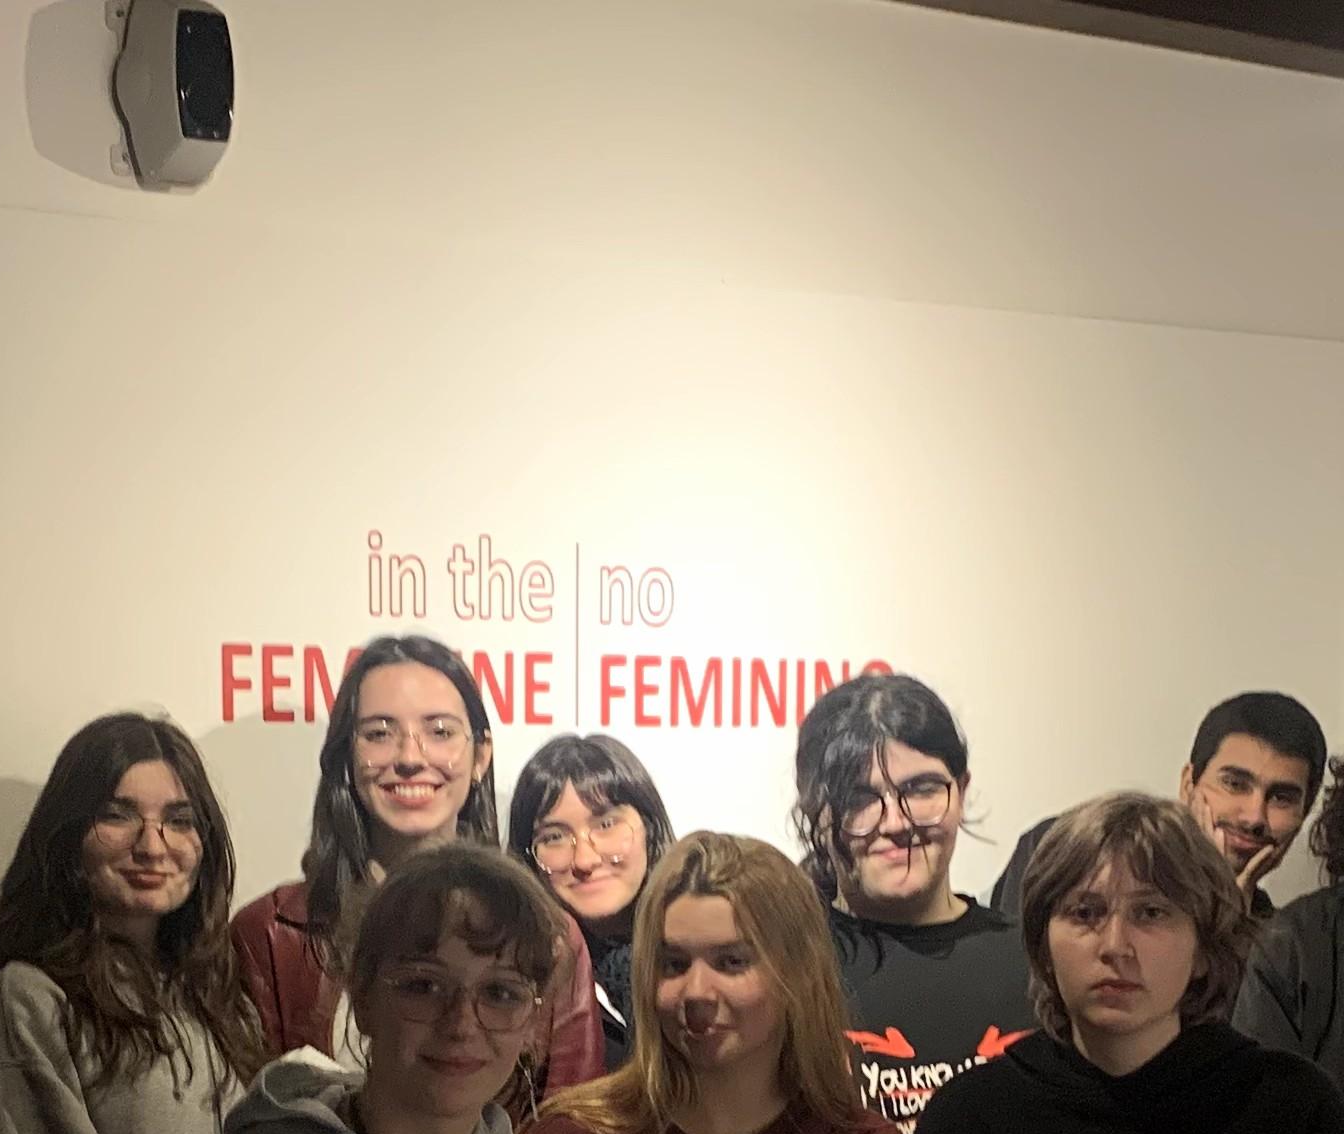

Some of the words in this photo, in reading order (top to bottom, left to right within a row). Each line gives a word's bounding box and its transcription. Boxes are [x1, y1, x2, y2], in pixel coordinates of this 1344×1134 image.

[367, 530, 427, 618] in
[447, 534, 555, 622] the
[598, 563, 675, 628] no
[861, 1061, 908, 1099] YOU
